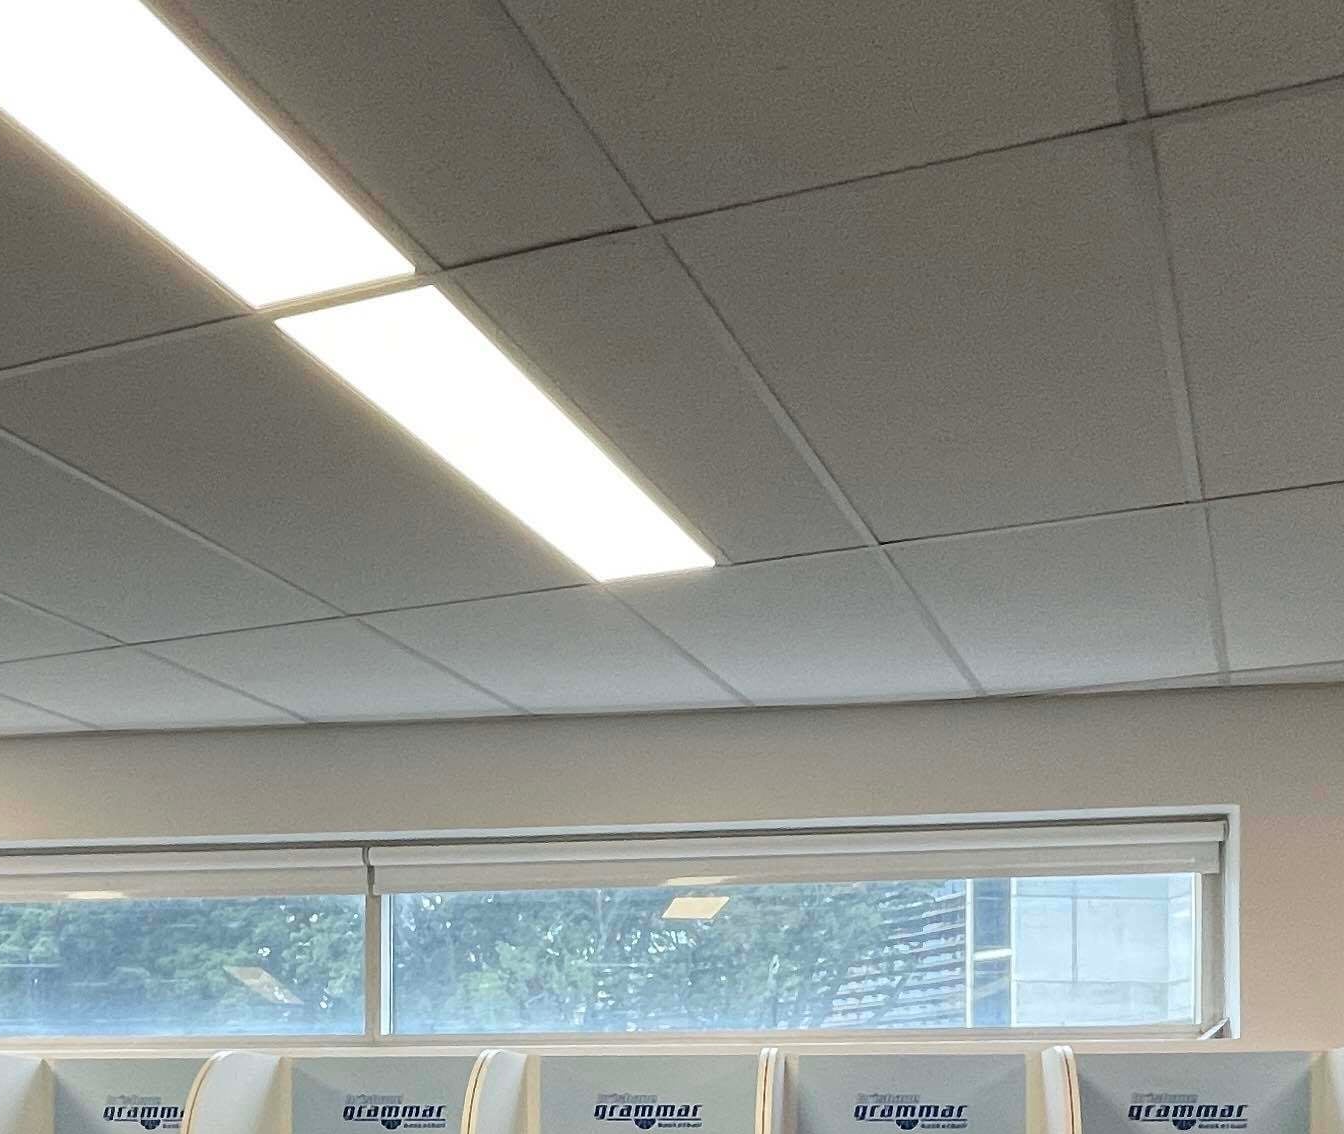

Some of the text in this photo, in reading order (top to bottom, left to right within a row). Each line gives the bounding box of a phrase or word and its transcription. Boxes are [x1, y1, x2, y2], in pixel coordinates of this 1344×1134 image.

[103, 1106, 184, 1121] gramm
[342, 1105, 447, 1121] grammar
[593, 1104, 703, 1120] grammar
[853, 1104, 968, 1120] grammar
[1127, 1104, 1248, 1120] grammar
